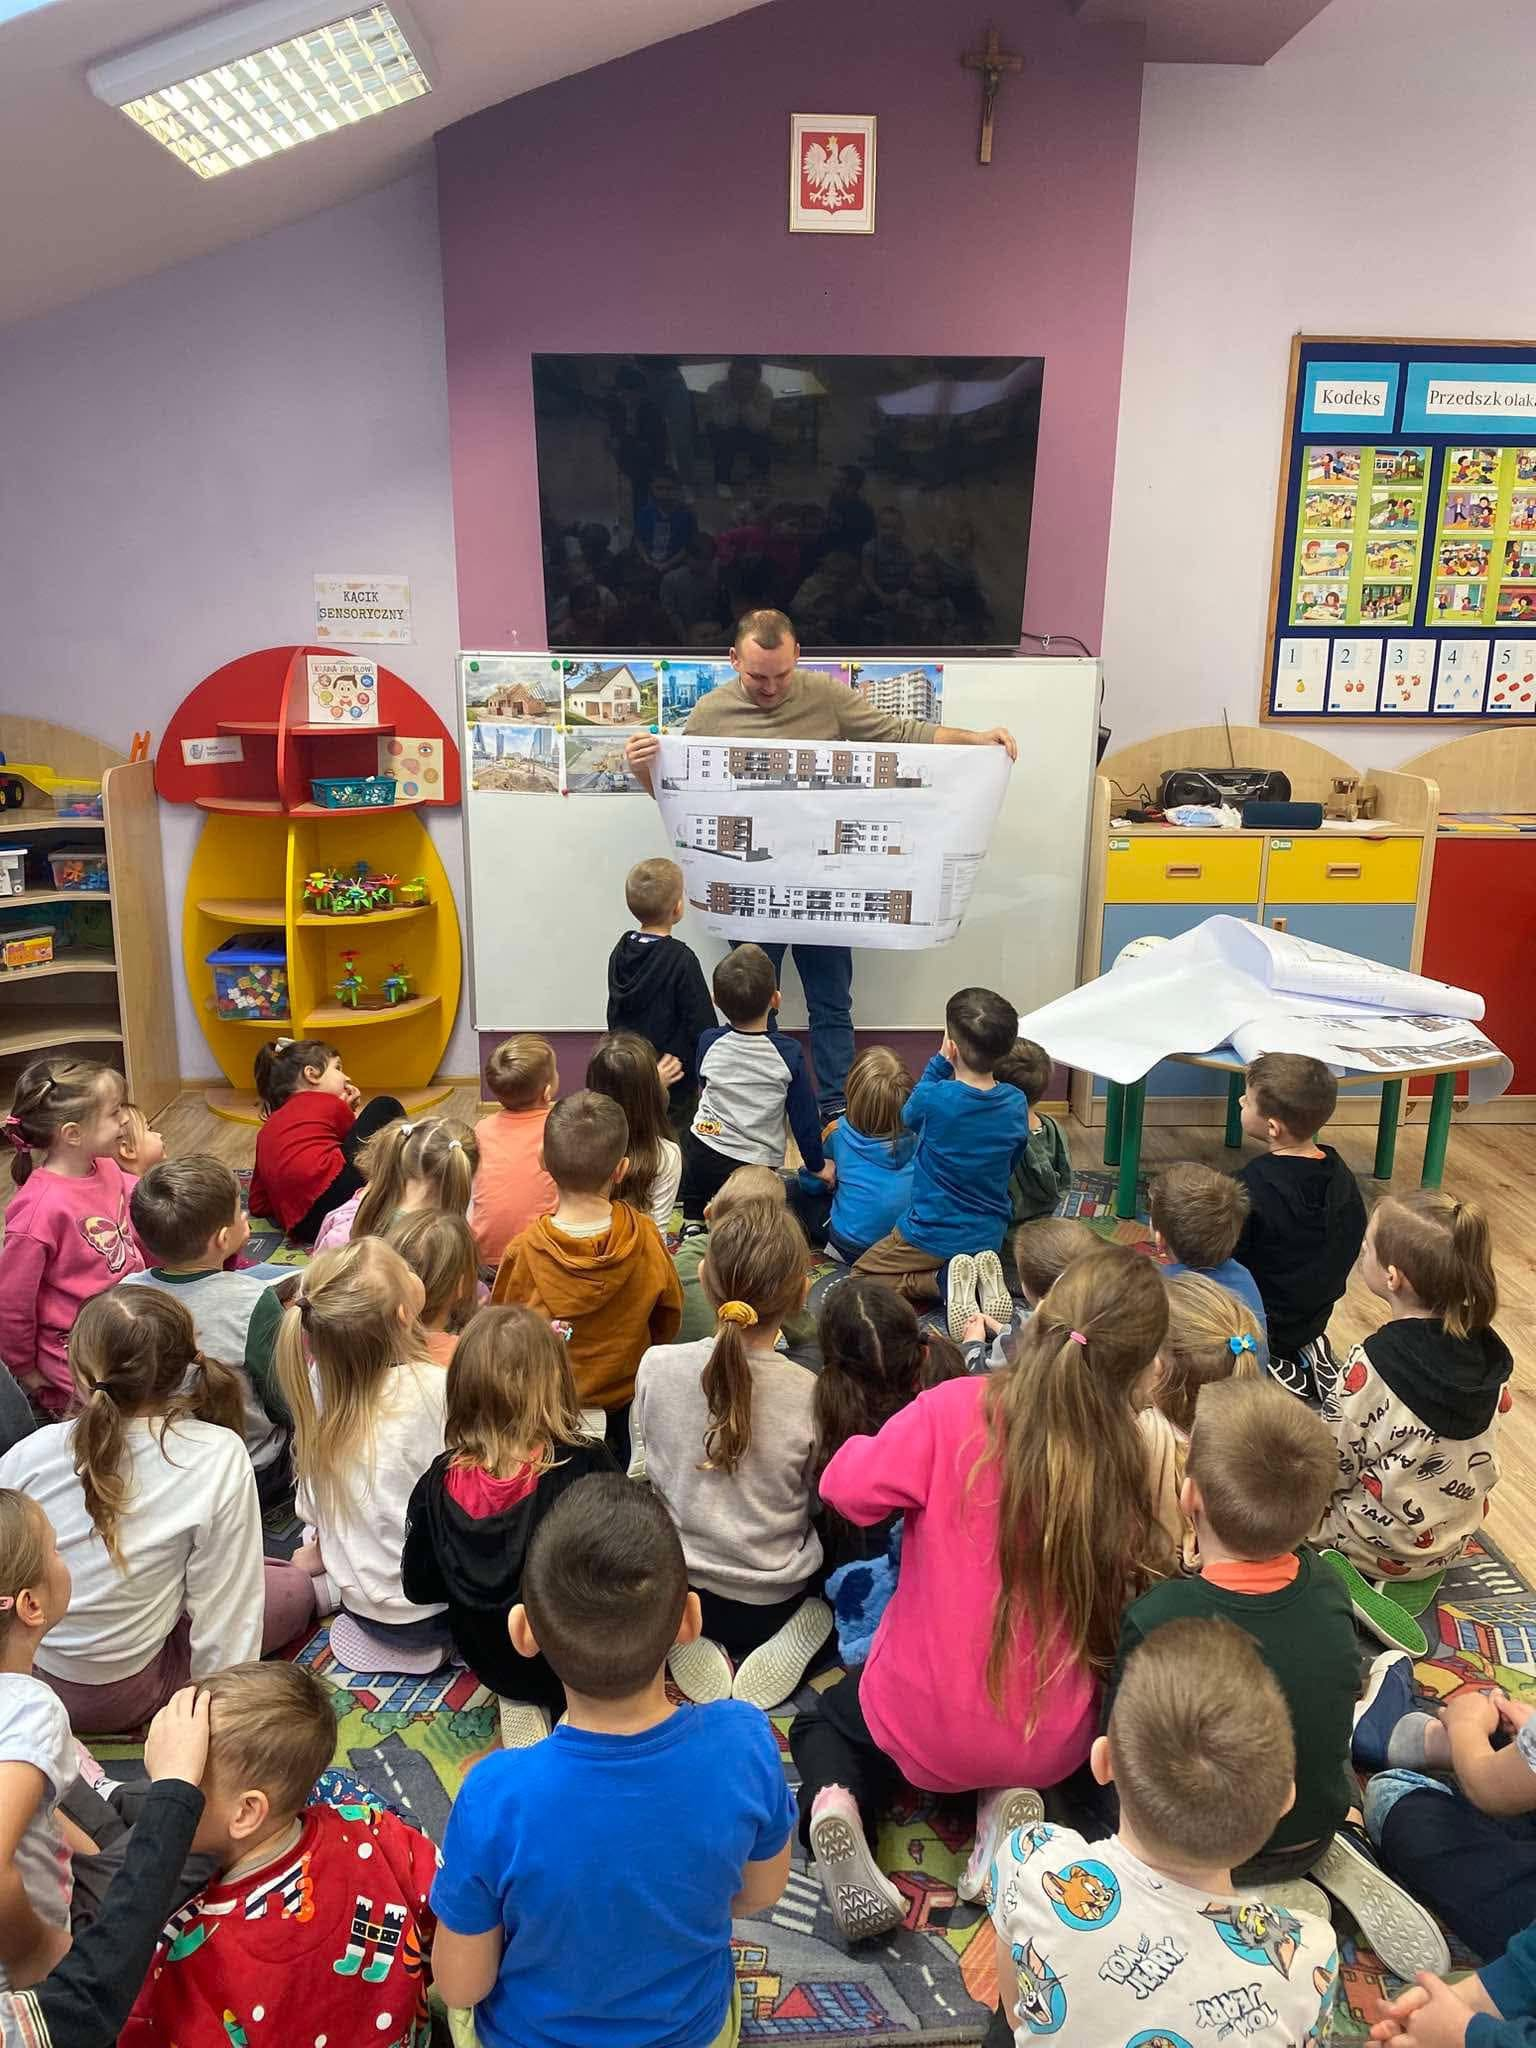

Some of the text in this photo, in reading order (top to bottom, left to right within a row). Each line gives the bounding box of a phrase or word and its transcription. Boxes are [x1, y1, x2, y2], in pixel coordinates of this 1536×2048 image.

[1322, 389, 1536, 408] Kodeks Przedszkolak
[343, 591, 379, 603] KĄCIK
[319, 608, 404, 620] SENSORYCZNY
[1289, 648, 1296, 664] 1
[1340, 648, 1352, 664] 2
[1394, 648, 1404, 664] 3
[1447, 649, 1457, 665] 4
[1501, 649, 1512, 665] 5
[1098, 1944, 1142, 1985] TOM
[1126, 1936, 1184, 2000] JERRY
[1232, 2001, 1279, 2038] TOM
